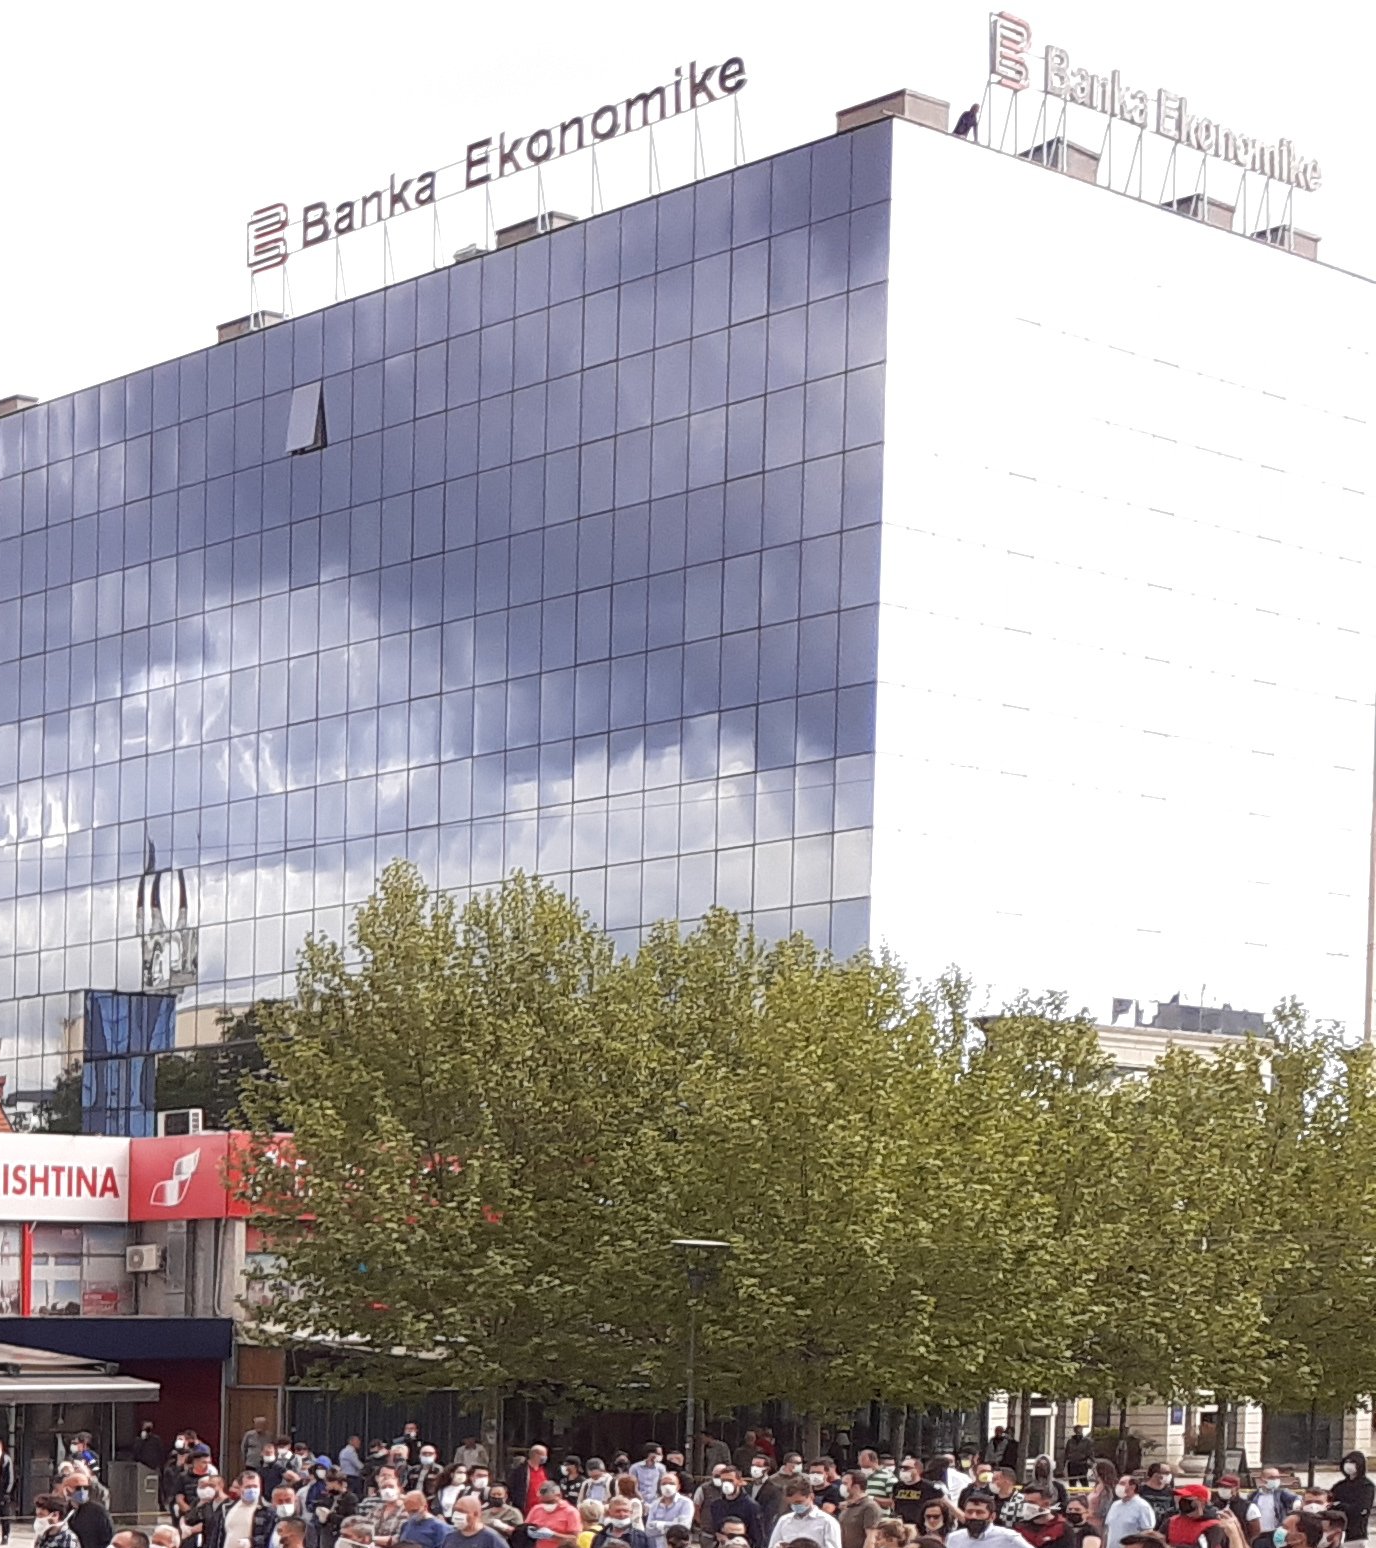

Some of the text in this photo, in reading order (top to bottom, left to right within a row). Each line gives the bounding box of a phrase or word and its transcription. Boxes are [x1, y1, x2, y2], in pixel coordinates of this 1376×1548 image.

[302, 56, 747, 248] Banka Ekonomike
[1045, 45, 1323, 192] Banka Ekonomike
